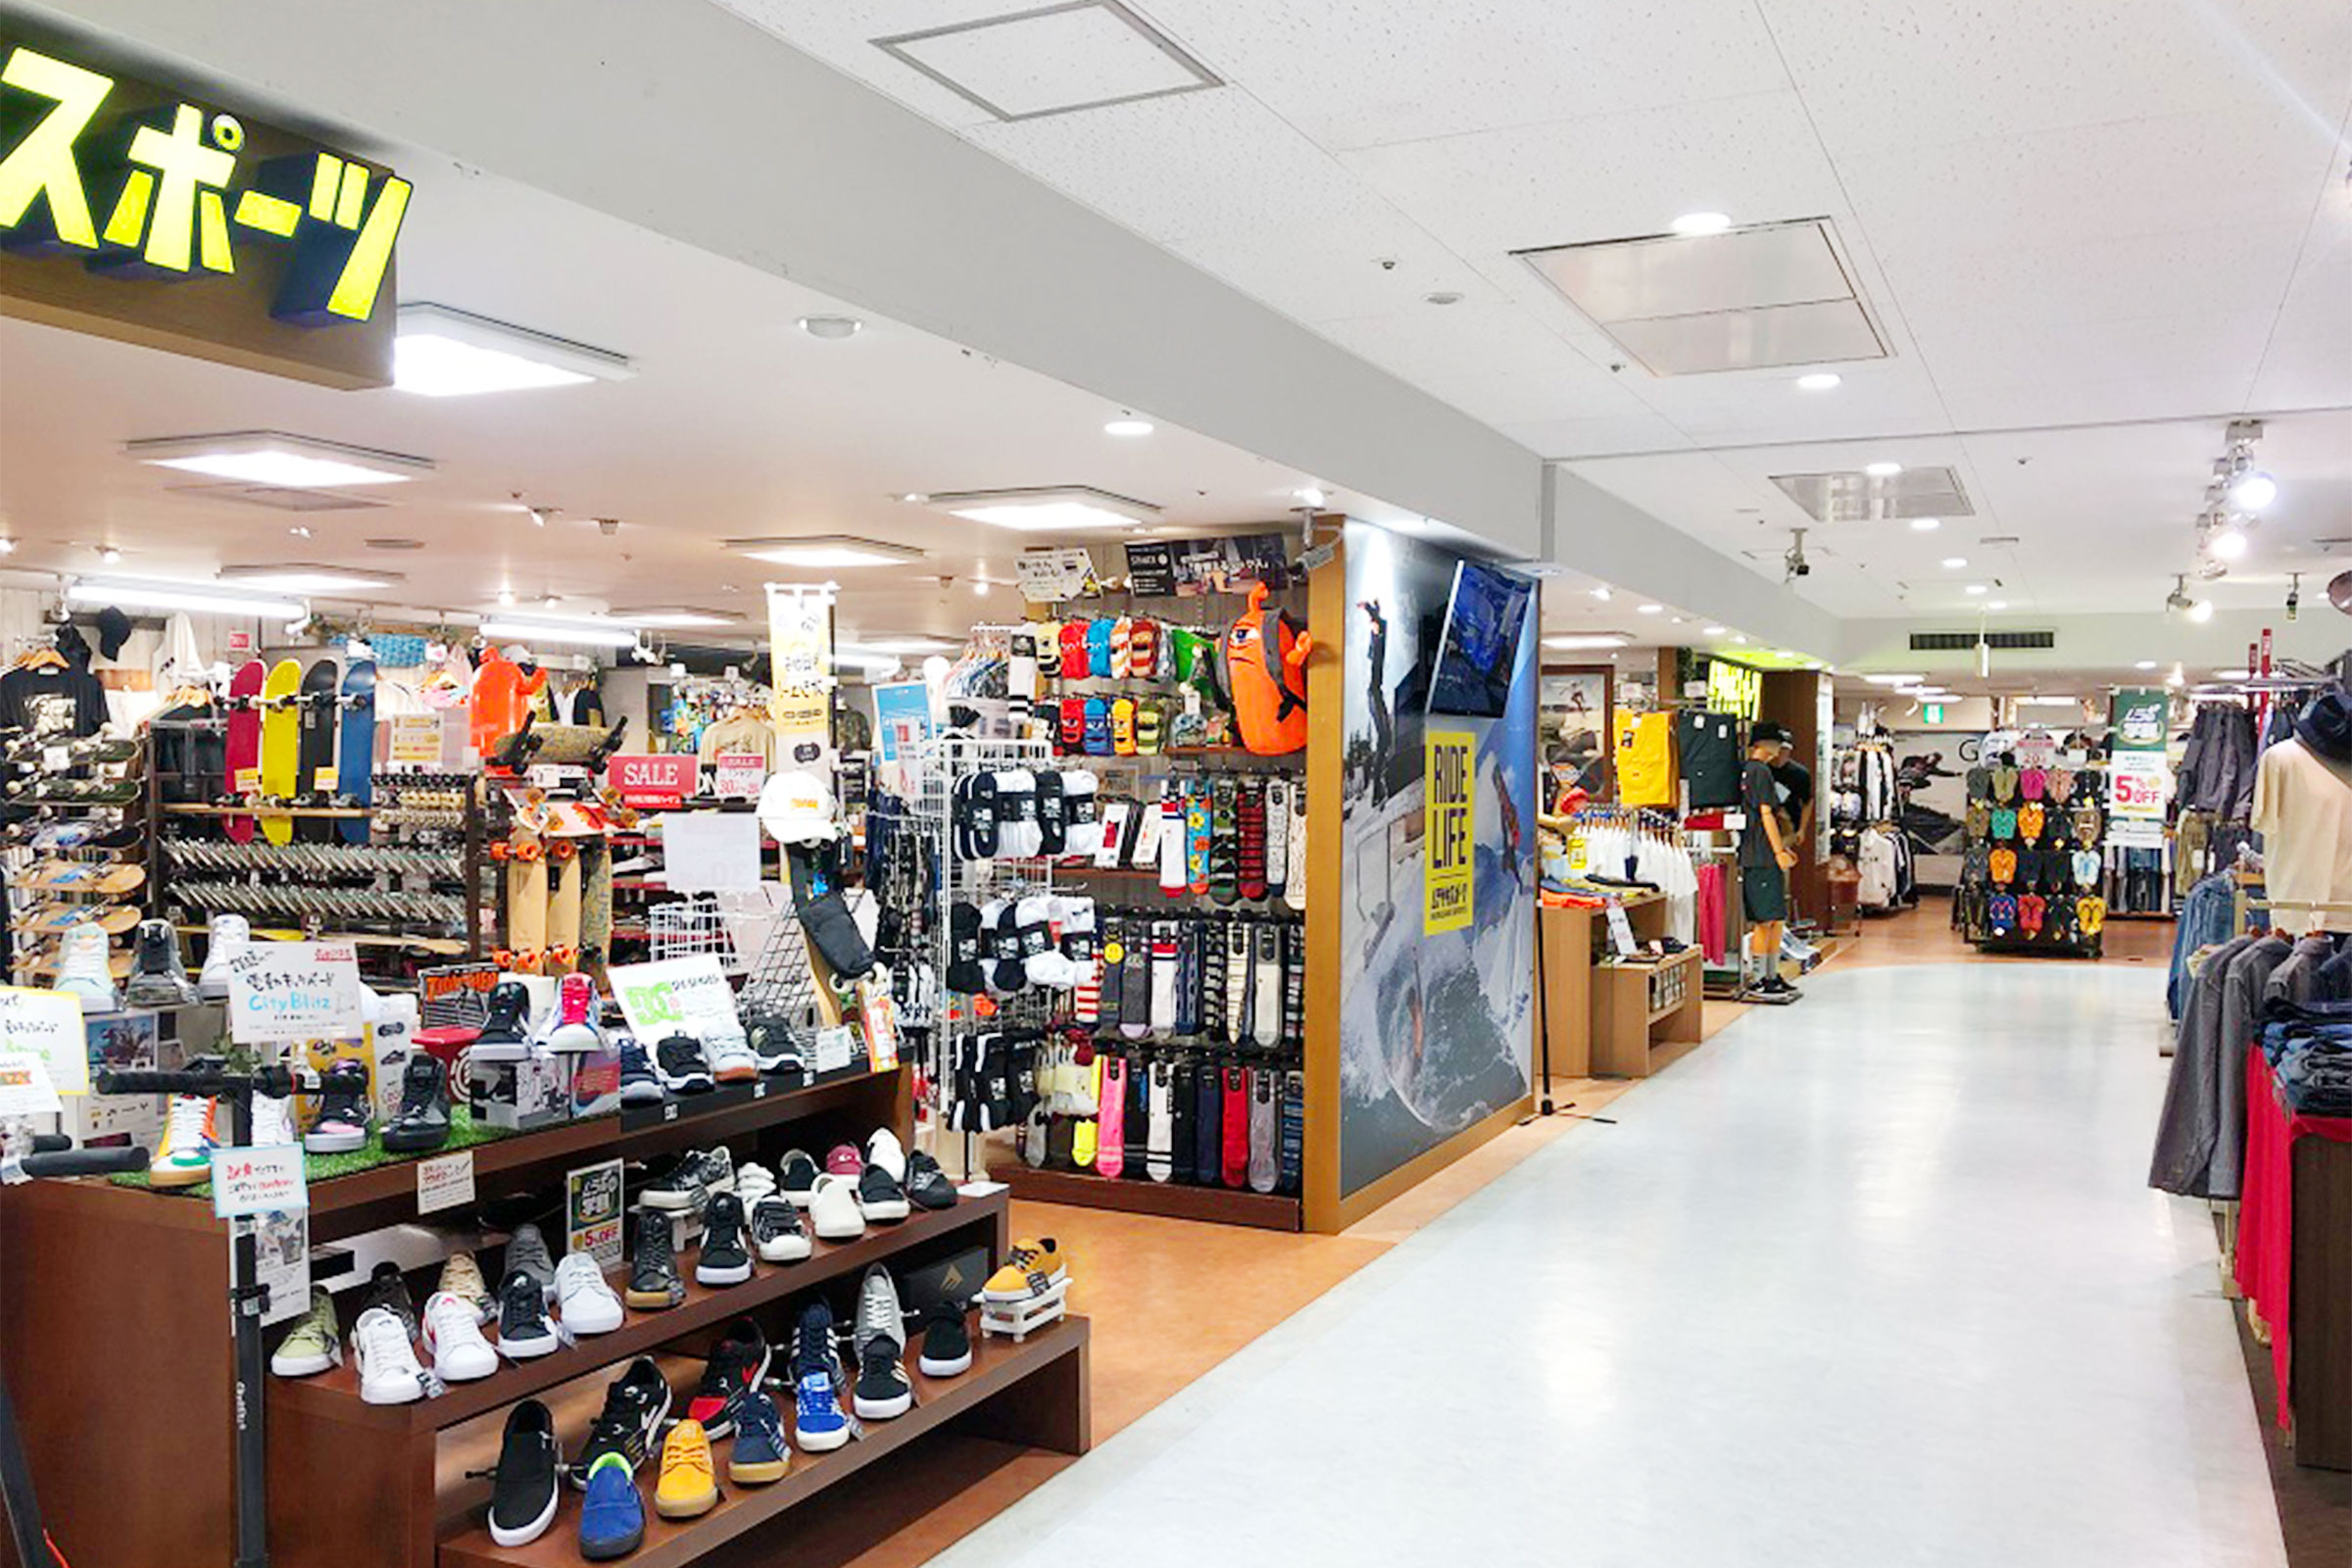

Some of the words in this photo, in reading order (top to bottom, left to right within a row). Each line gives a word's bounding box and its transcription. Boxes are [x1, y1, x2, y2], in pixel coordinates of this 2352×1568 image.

[0, 46, 413, 321] スポーツ
[623, 762, 678, 786] SALE
[1434, 745, 1468, 804] RIDE
[1433, 808, 1467, 869] LIFE
